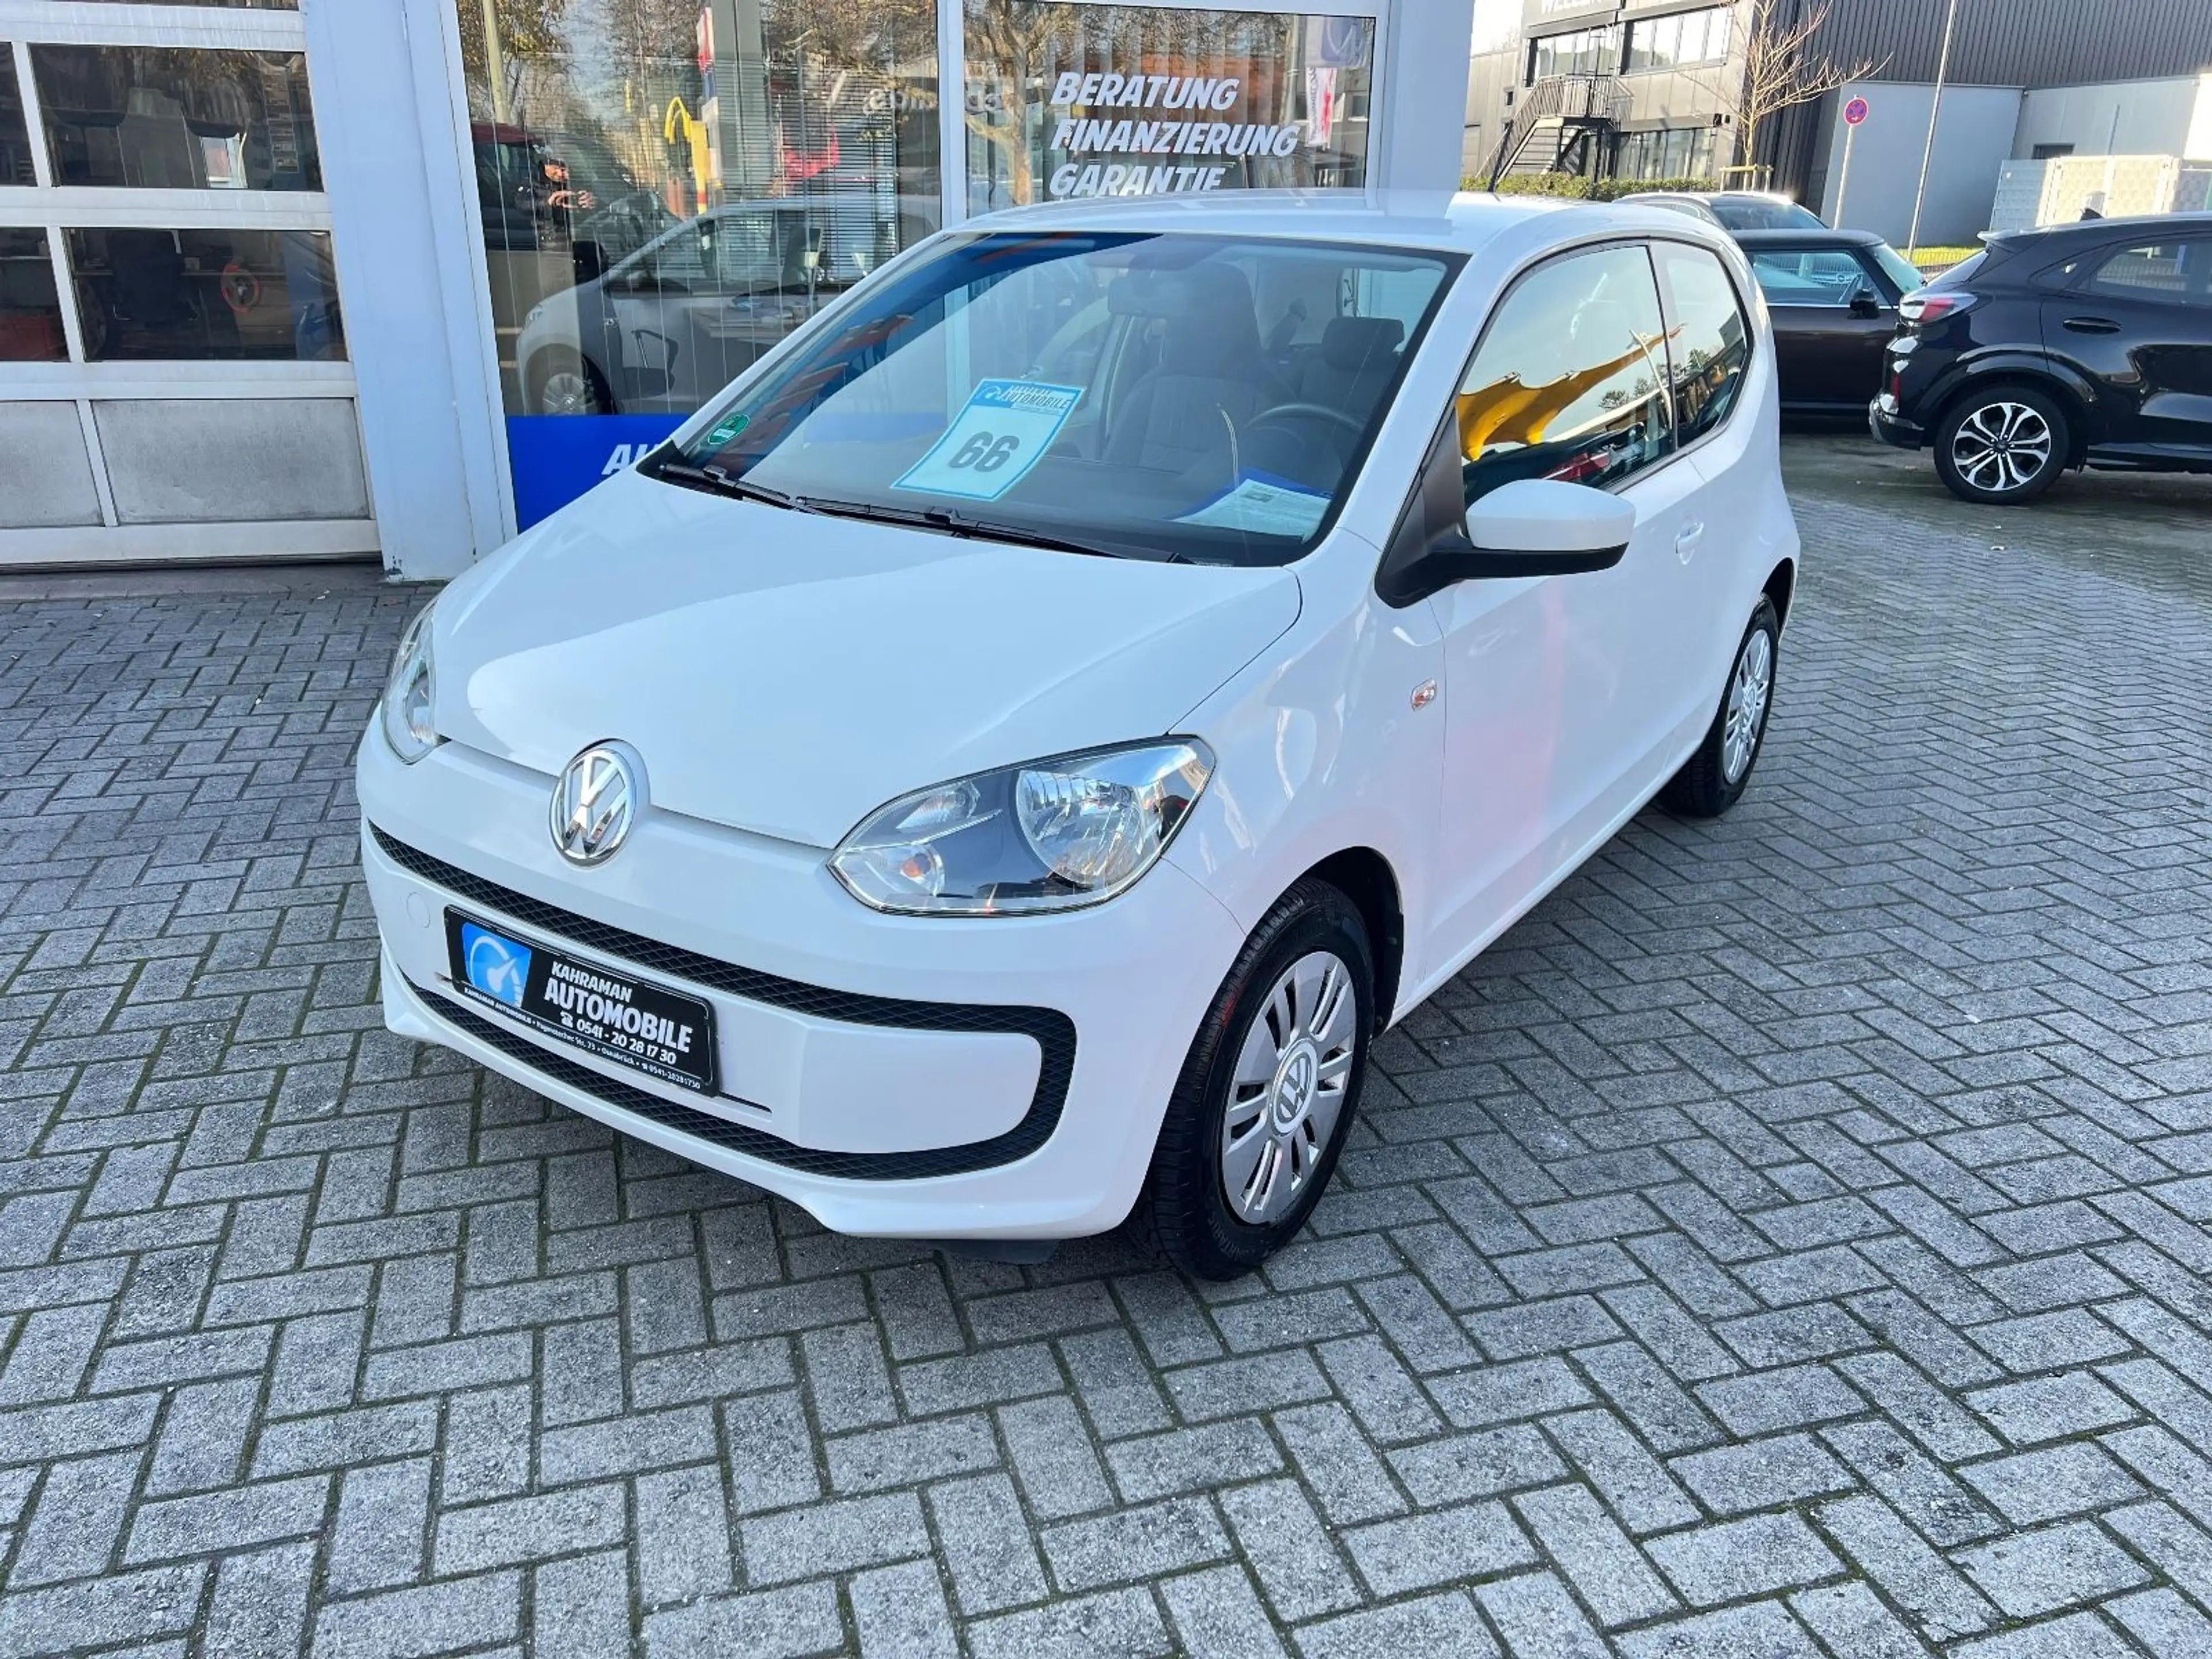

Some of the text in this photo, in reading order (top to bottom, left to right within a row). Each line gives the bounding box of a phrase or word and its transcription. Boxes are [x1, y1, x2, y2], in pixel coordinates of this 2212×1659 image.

[1050, 71, 1240, 110] BERATUNG
[1050, 118, 1300, 157] FINANZIERUNG
[1049, 164, 1226, 196] GARANTIE
[948, 431, 1020, 472] 66
[551, 961, 632, 1002] KAHRAMAN
[544, 977, 693, 1053] AUTOMOBILE
[577, 1019, 603, 1039] 0541
[611, 1031, 627, 1047] 20
[628, 1038, 644, 1054] 28
[646, 1044, 659, 1057] 17
[660, 1050, 677, 1065] 30
